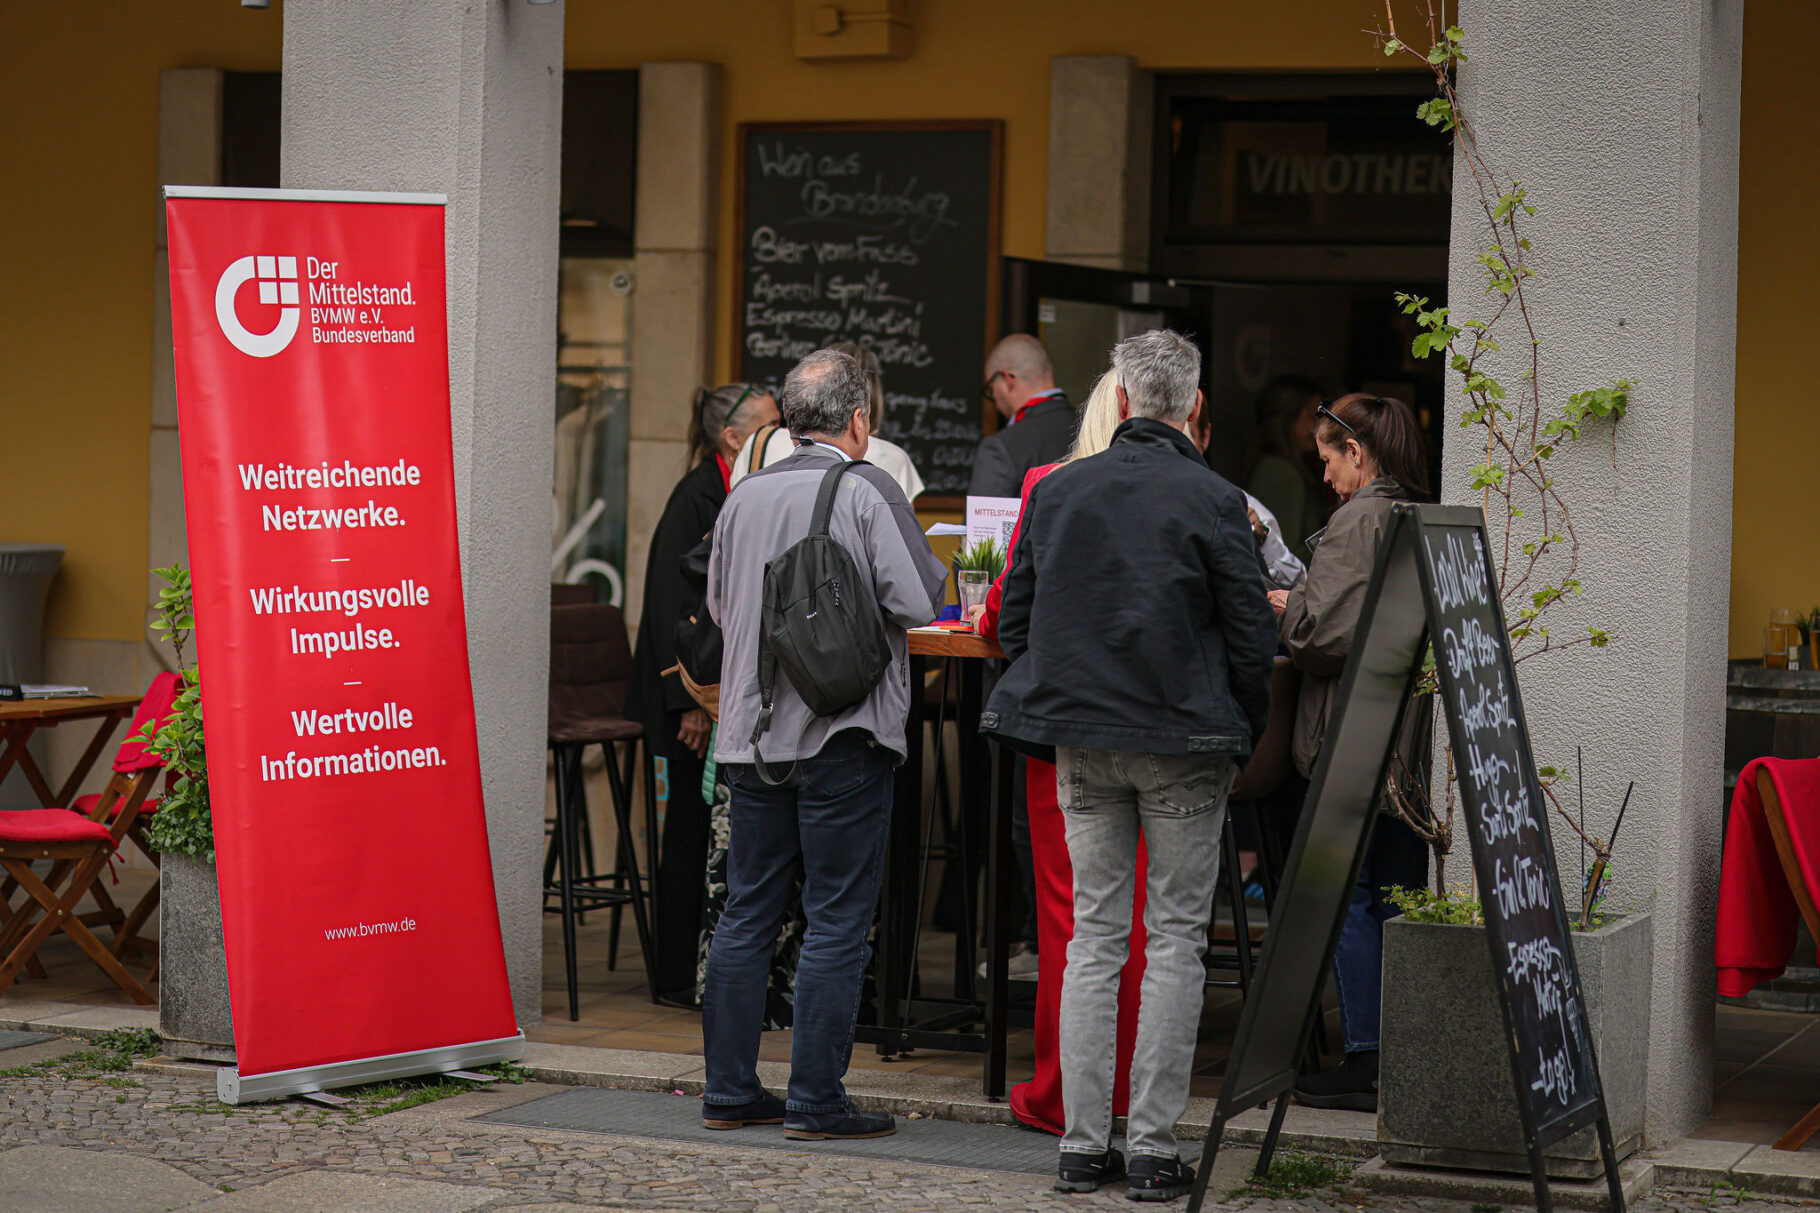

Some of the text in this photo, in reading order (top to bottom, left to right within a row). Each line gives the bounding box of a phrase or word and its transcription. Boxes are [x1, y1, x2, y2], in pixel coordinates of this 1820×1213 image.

[306, 256, 339, 280] Der
[308, 281, 416, 306] Mittelstand.
[310, 307, 384, 324] BVMW e.V.
[746, 301, 925, 338] Espresso Martini
[312, 325, 415, 344] Bundesverband
[238, 458, 421, 491] Weitreichende
[262, 499, 406, 532] Netzwerke.
[249, 579, 430, 617] Wirkungsvolle
[290, 622, 400, 659] Impulse.
[290, 702, 413, 737] Wertvolle
[261, 744, 447, 782] Informationen.
[324, 917, 416, 941] www.bvmw.de
